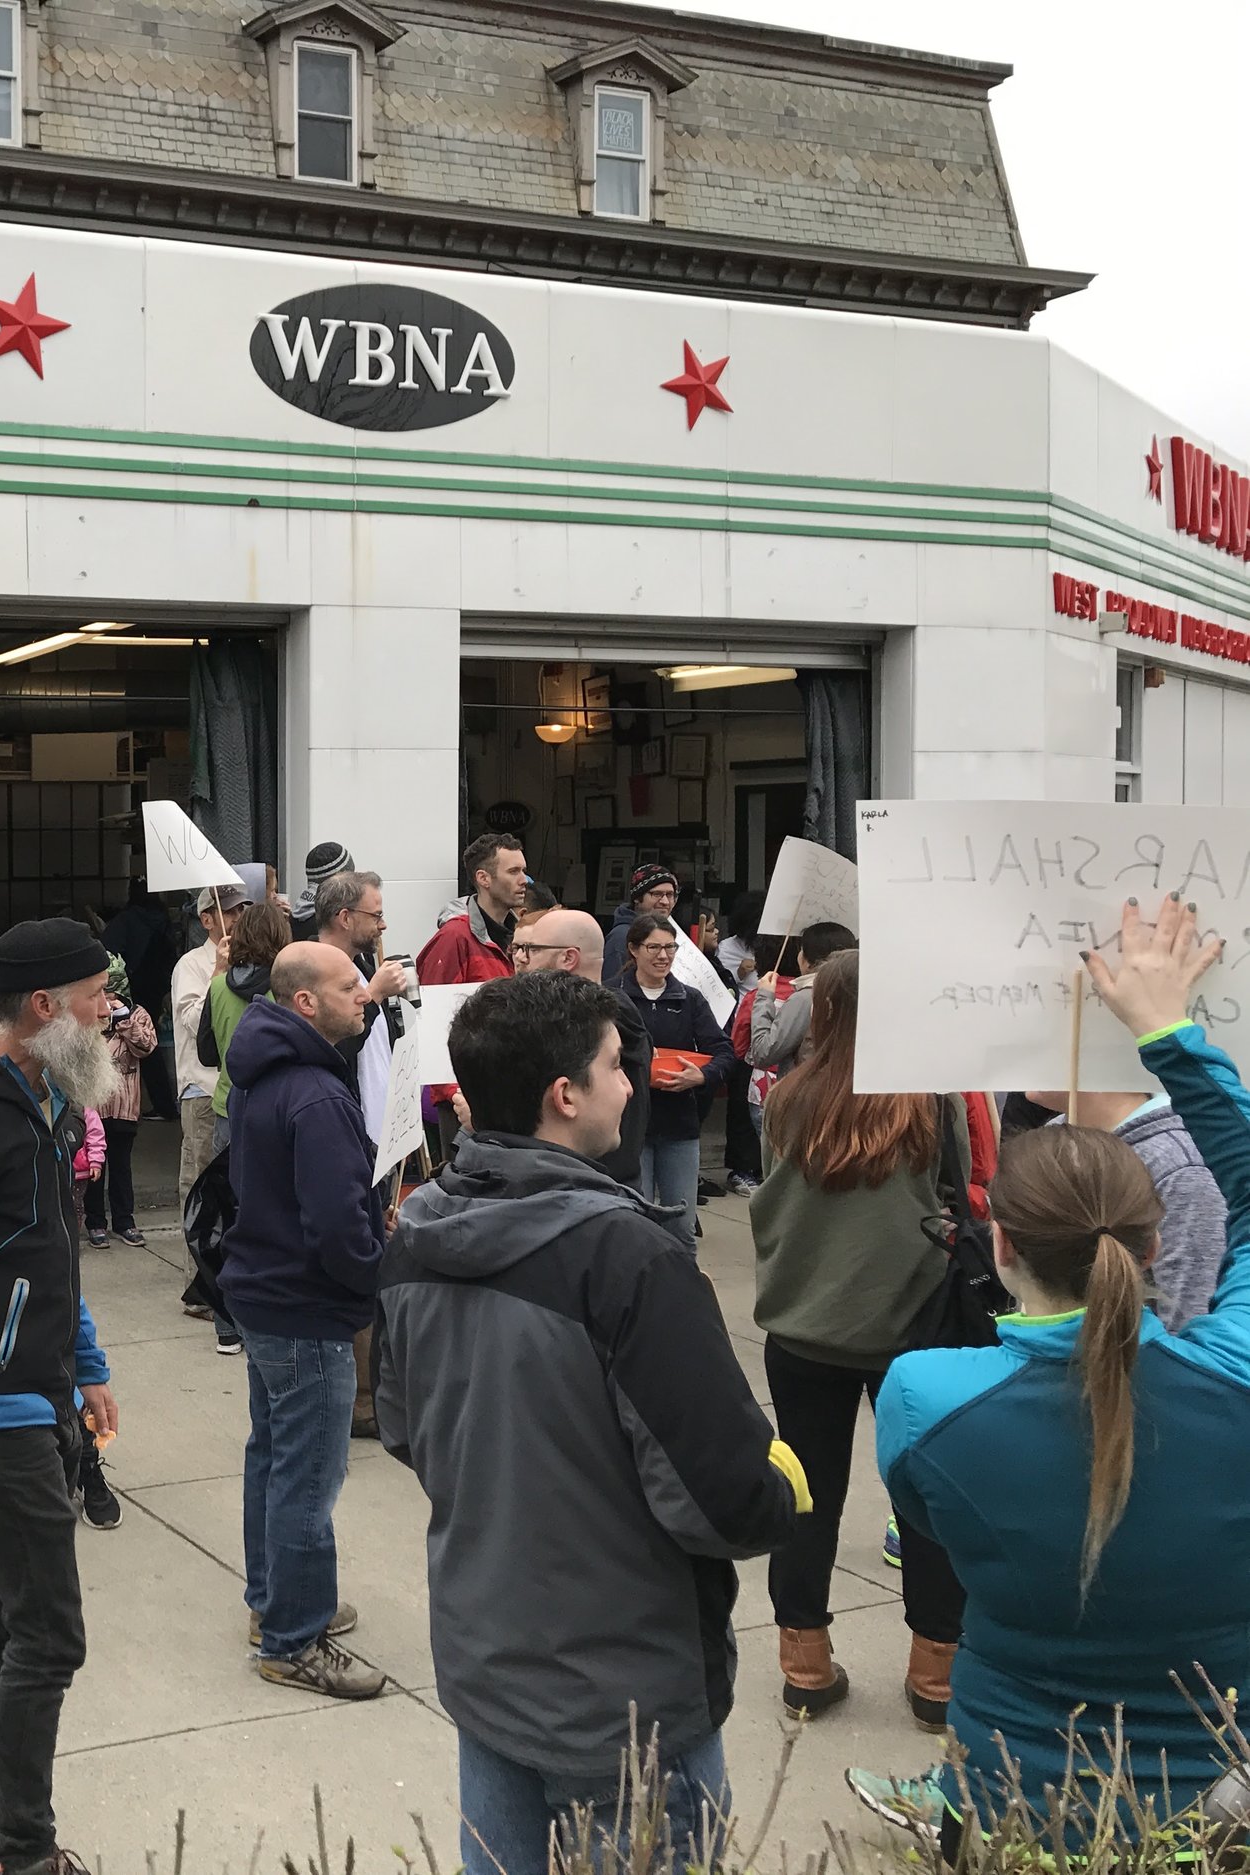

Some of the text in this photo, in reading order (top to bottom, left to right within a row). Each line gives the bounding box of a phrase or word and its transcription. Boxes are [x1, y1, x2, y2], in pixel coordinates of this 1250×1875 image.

[256, 312, 511, 400] WBNA
[1170, 436, 1250, 562] WBN
[1053, 572, 1100, 622] WEST
[861, 809, 889, 820] KARLA
